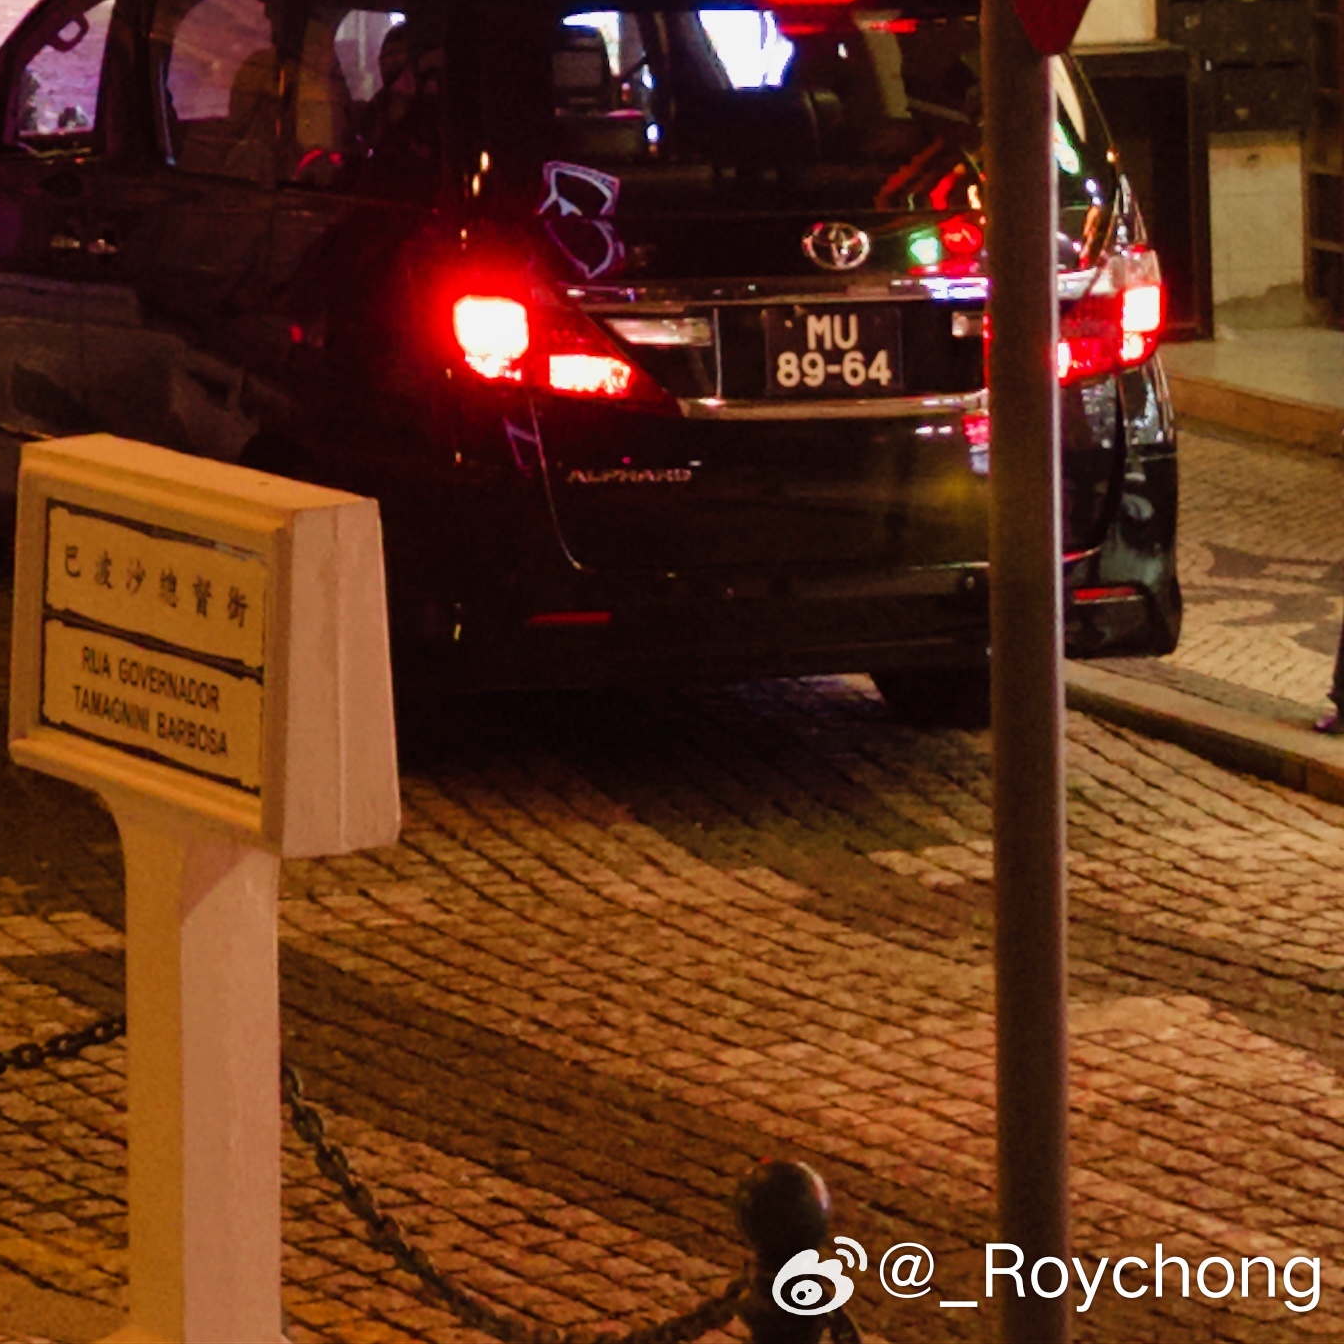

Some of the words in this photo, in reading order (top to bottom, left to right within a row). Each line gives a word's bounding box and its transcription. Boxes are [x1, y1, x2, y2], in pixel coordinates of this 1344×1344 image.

[807, 314, 858, 350] MU
[776, 350, 892, 388] 89-64
[63, 544, 249, 628] 巴波沙總督街
[81, 646, 112, 678] RUA
[118, 657, 220, 712] GOVERNADOR
[72, 684, 150, 735] TAMAGNINI
[157, 712, 229, 757] BARBOSA
